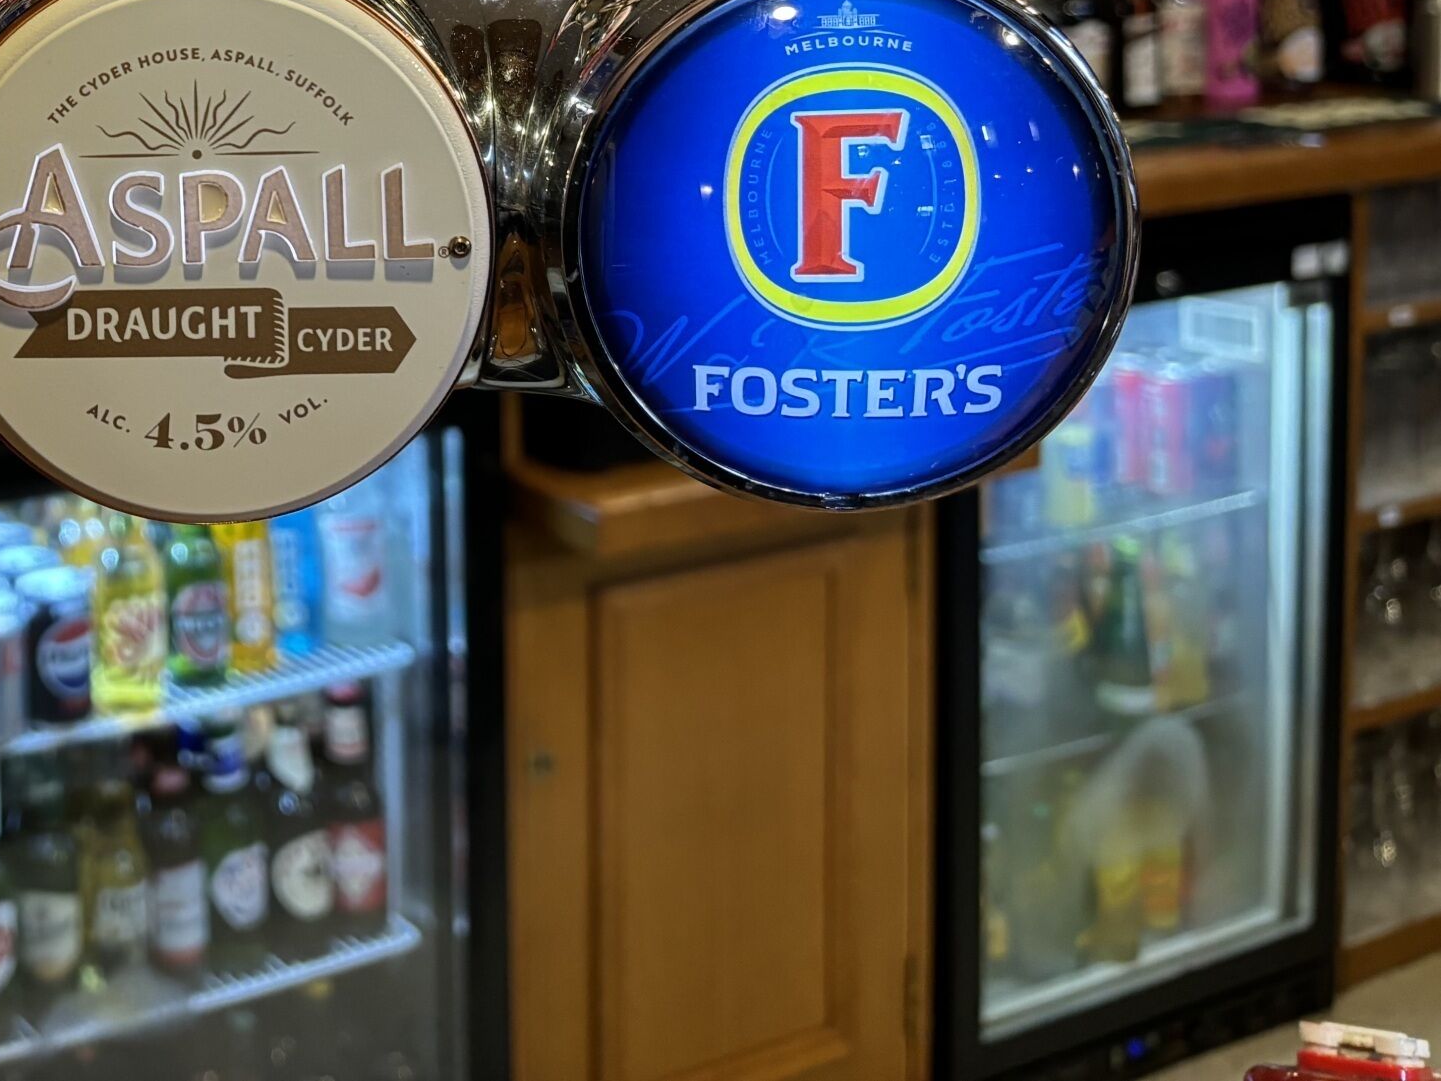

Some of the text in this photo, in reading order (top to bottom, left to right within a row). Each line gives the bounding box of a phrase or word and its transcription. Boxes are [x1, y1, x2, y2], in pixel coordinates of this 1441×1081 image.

[785, 35, 913, 56] MELBOURNE
[47, 94, 78, 125] THE
[78, 61, 133, 97] CYDER
[137, 47, 206, 69] HOUSE,
[284, 69, 355, 127] SUFFOLK
[747, 128, 774, 265] MELBOURNE
[790, 108, 910, 283] F
[66, 305, 264, 344] DRAUGHT
[296, 326, 394, 353] CYDER
[691, 362, 1003, 419] FOSTER'S
[86, 396, 329, 452] ALC. 4.5% VOL.
